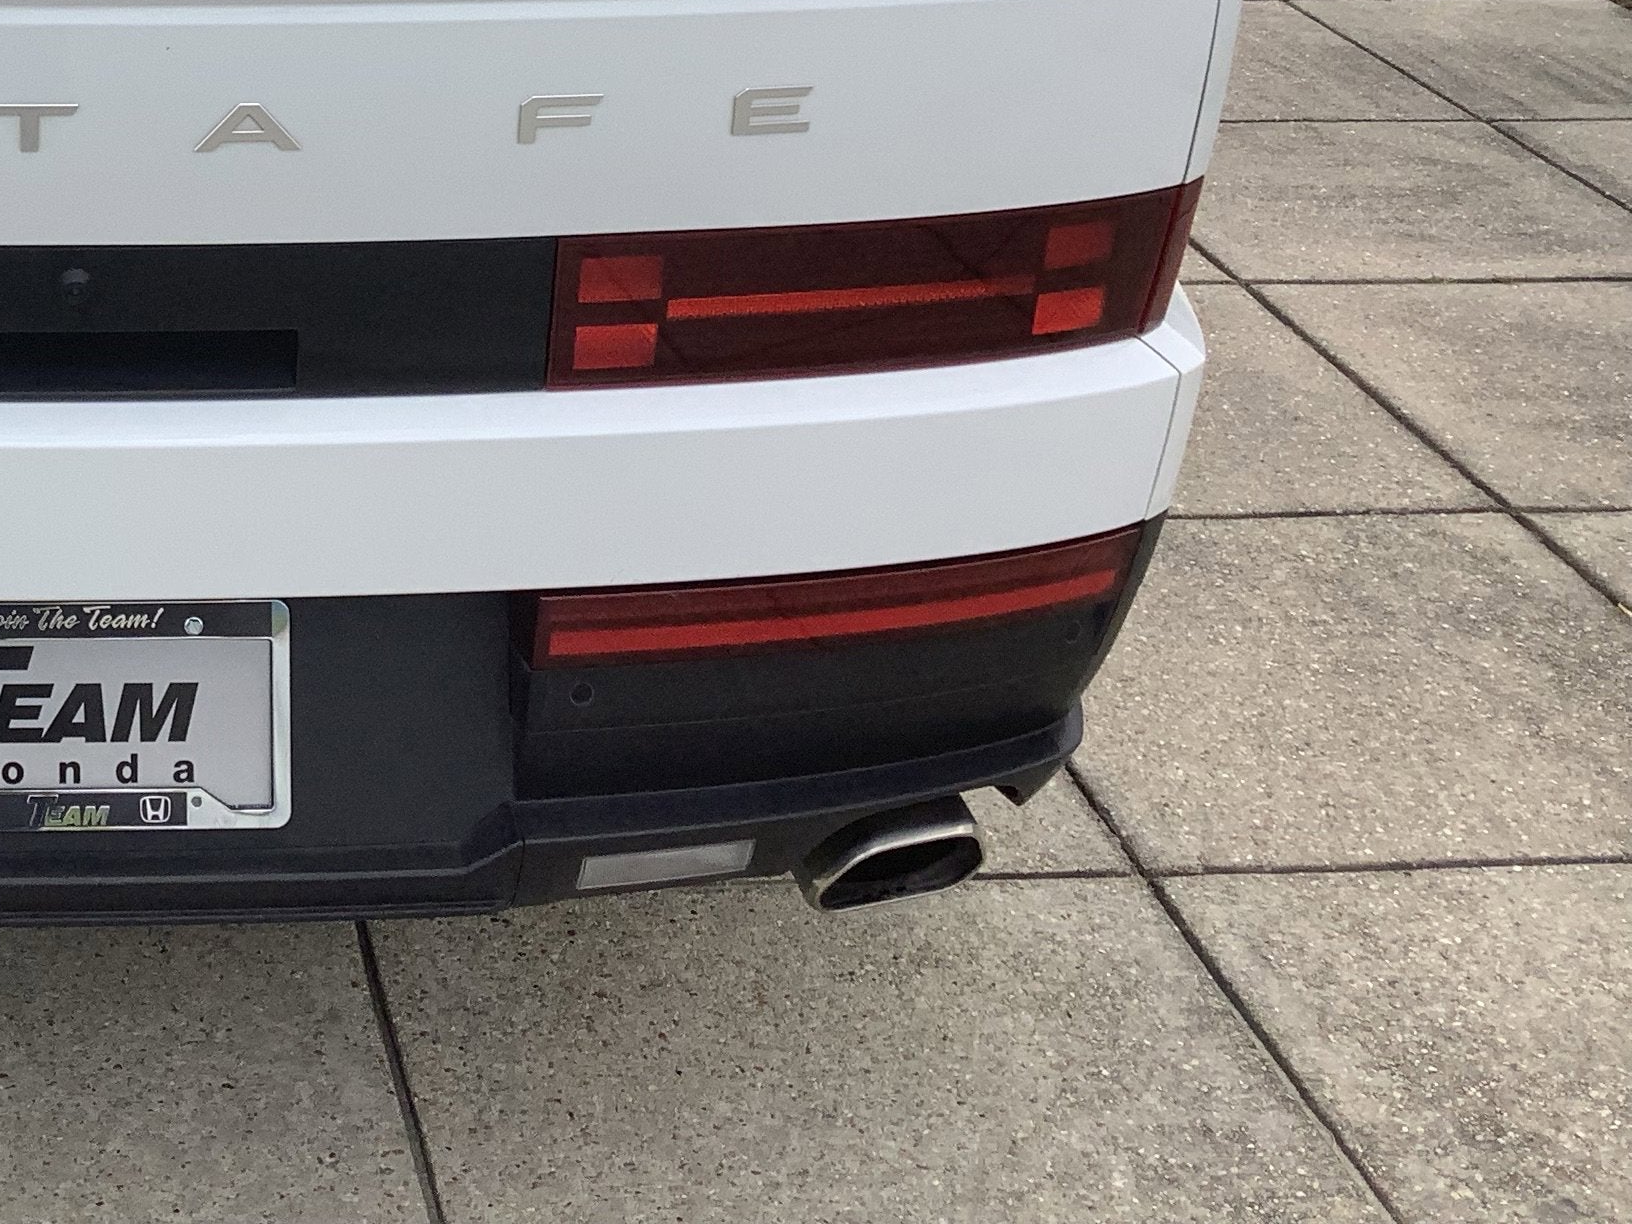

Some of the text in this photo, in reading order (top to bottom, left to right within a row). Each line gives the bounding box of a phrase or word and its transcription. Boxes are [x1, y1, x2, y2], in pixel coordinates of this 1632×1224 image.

[516, 84, 815, 144] FE
[32, 605, 80, 631] The
[82, 605, 165, 631] Team!
[26, 794, 110, 826] TEAM
